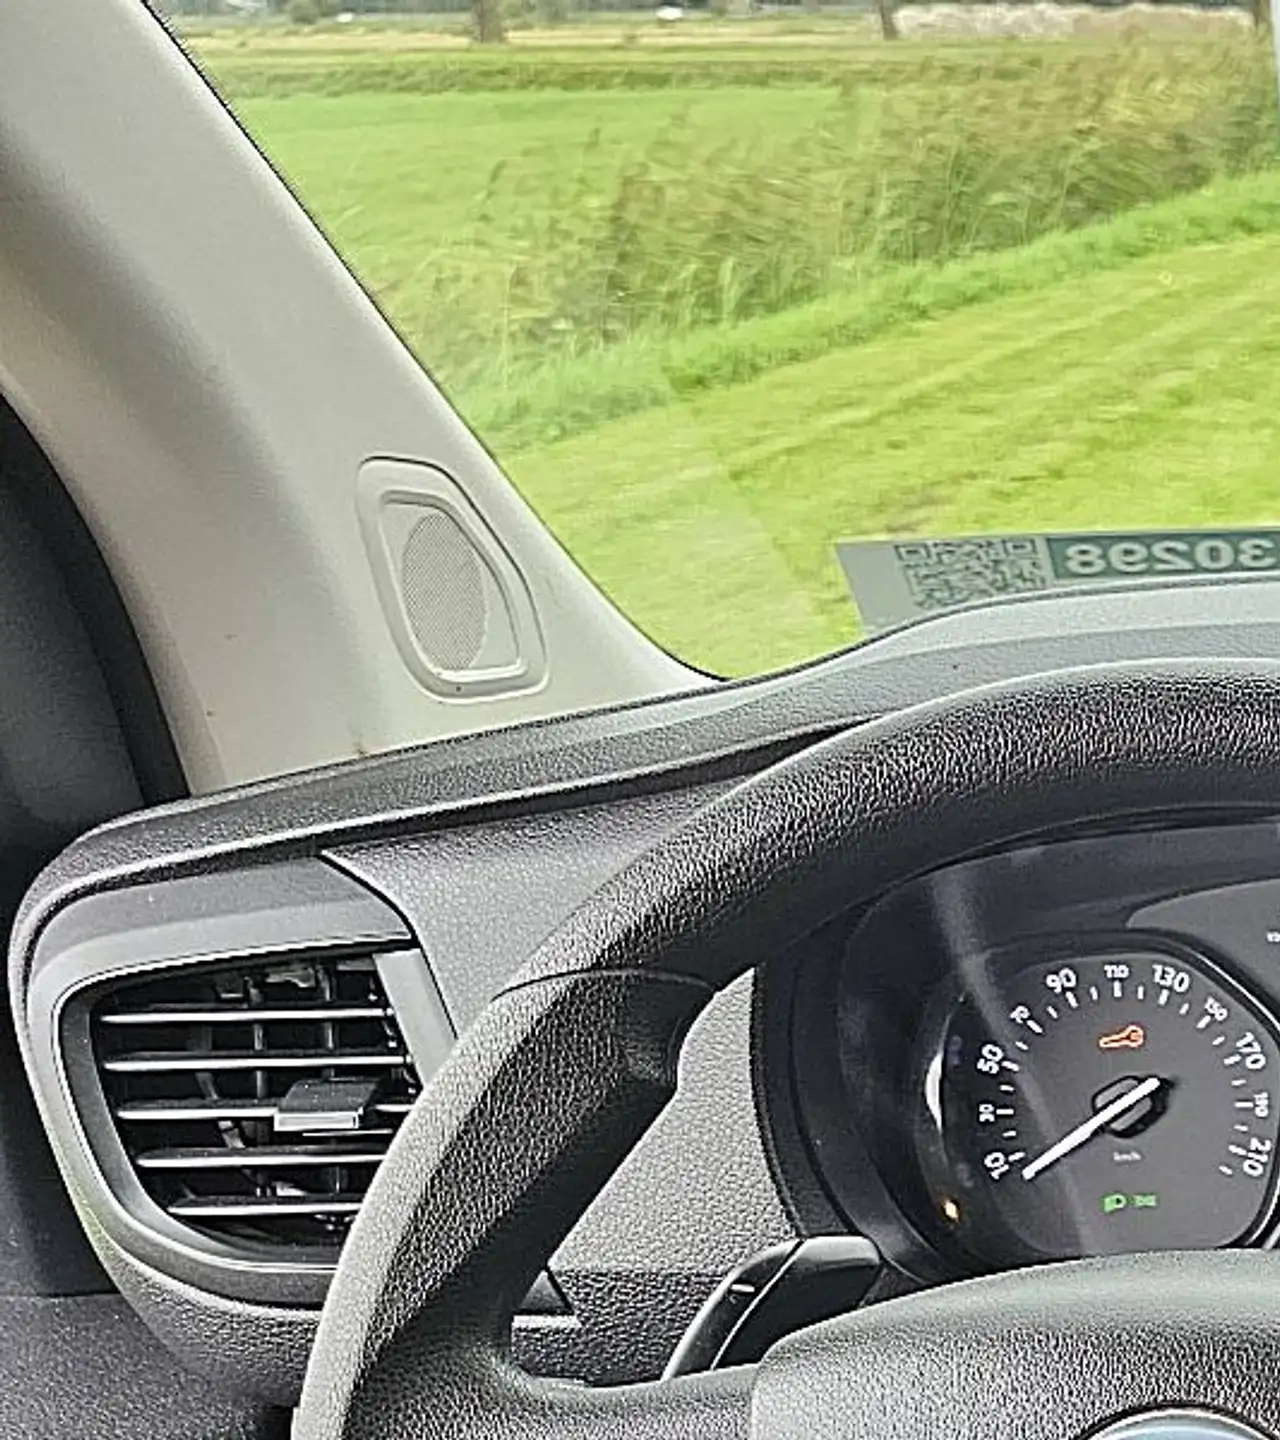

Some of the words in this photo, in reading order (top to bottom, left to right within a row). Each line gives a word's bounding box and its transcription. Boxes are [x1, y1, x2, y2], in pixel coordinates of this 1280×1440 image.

[1046, 967, 1078, 994] 90
[1104, 964, 1130, 980] 110
[1152, 964, 1192, 994] 130
[1010, 1004, 1031, 1025] 70
[1204, 996, 1229, 1023] 150
[976, 1043, 1005, 1076] 50
[1235, 1032, 1266, 1072] 170
[978, 1103, 996, 1124] 30
[983, 1152, 1011, 1181] 10
[1243, 1138, 1273, 1178] 210
